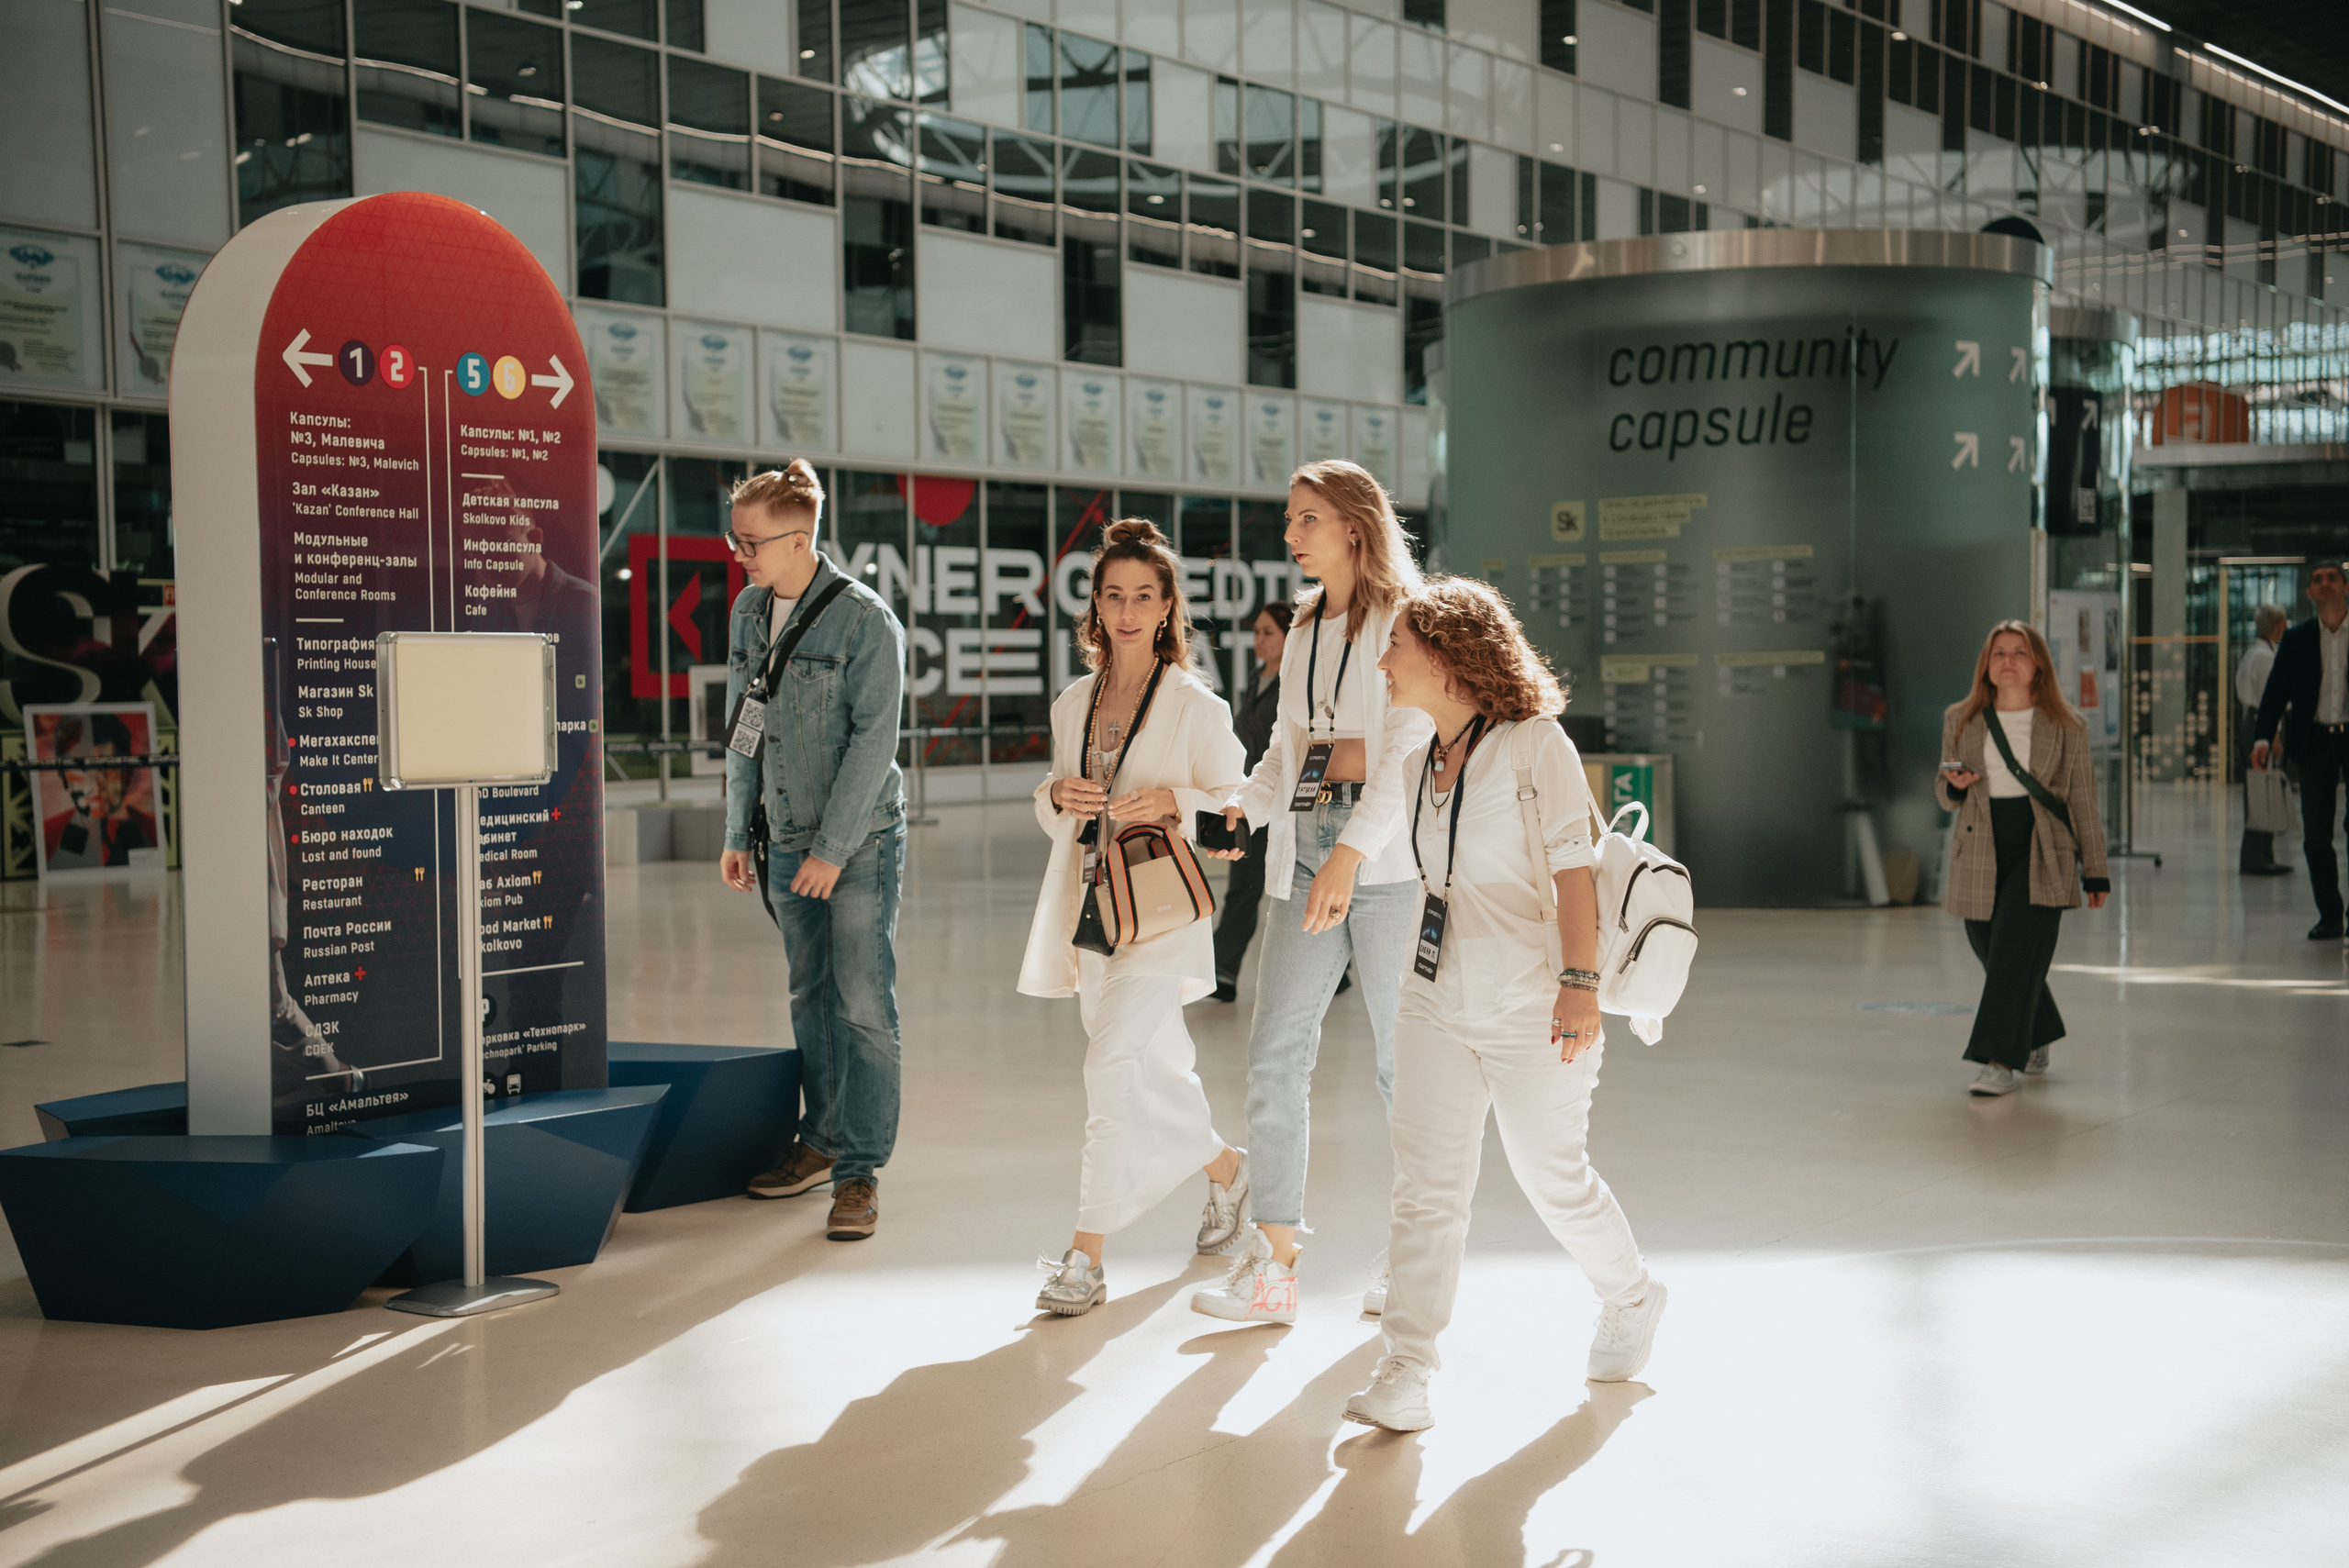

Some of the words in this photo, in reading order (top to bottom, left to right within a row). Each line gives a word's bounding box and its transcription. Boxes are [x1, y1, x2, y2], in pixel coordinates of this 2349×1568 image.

[349, 347, 362, 378] 1
[390, 350, 404, 382] 2
[1609, 324, 1900, 391] community
[467, 358, 481, 389] 5
[503, 362, 516, 392] 6
[290, 411, 351, 428] Капсулы:
[1609, 392, 1814, 462] capsule
[290, 430, 317, 448] №3,
[321, 433, 385, 450] Малевича
[461, 424, 515, 440] Капсулы:
[518, 428, 539, 444] №1,
[542, 431, 562, 444] №2
[461, 444, 509, 459] Capsules:
[532, 449, 549, 461] №2
[291, 451, 346, 467] Capsules:
[349, 455, 370, 470] №3,
[373, 457, 419, 471] Malevich
[292, 482, 317, 496] Зал
[321, 484, 380, 498] «Казан»
[462, 493, 510, 508] Детская
[514, 497, 560, 511] капсула
[292, 502, 332, 516] 'Kazan'
[335, 505, 395, 519] Conference
[398, 507, 419, 520] Hall
[462, 512, 507, 526] Skolkovo
[509, 514, 530, 527] Kids
[294, 531, 369, 548] Модульные
[463, 538, 542, 554] Инфокапсула
[294, 552, 302, 565] и
[306, 551, 417, 569] конференц-залы
[463, 558, 483, 571] Info
[485, 558, 524, 573] Capsule
[295, 572, 339, 584] Modular
[342, 573, 362, 585] and
[295, 587, 357, 600] Conference
[361, 589, 396, 602] Rooms
[464, 584, 518, 601] Кофейня
[465, 604, 487, 617] Cafe
[296, 637, 375, 653] Типография
[296, 657, 340, 673] Printing
[343, 658, 377, 671] House
[298, 685, 354, 699] Магазин
[358, 684, 374, 698] Sk
[298, 706, 313, 718] Sk
[316, 705, 344, 720] Shop
[299, 734, 379, 748] Мегахакспе
[299, 753, 328, 767] Make
[331, 753, 340, 766] It
[343, 752, 379, 765] Center
[300, 782, 362, 796] Столовая
[492, 784, 540, 798] Boulevard
[301, 803, 345, 816] Canteen
[480, 808, 550, 828] едицинский
[302, 830, 337, 846] Бюро
[341, 827, 394, 842] находок
[478, 831, 517, 845] абинет
[302, 851, 326, 863] Lost
[328, 848, 349, 862] and
[352, 845, 383, 859] found
[479, 849, 508, 862] edical
[511, 848, 538, 860] Room
[302, 876, 363, 892] Ресторан
[480, 878, 493, 890] аб
[496, 874, 531, 889] Axiom
[303, 895, 362, 911] Restaurant
[480, 895, 502, 907] xiom
[505, 893, 523, 906] Pub
[303, 926, 342, 940] Почта
[346, 920, 392, 935] России
[480, 921, 499, 936] ood
[503, 917, 541, 932] Market
[304, 943, 347, 959] Russian
[351, 940, 375, 954] Post
[481, 938, 522, 953] kolkovo
[304, 972, 351, 987] Аптека
[305, 990, 359, 1006] Pharmacy
[305, 1020, 340, 1038] СДЭК
[482, 1030, 520, 1047] арковка
[523, 1022, 586, 1039] «Технопарк»
[305, 1041, 335, 1057] CDEK
[527, 1040, 558, 1054] Parking
[306, 1102, 325, 1118] БЦ
[328, 1091, 409, 1112] «Амальтея»
[306, 1119, 357, 1136] Amalt
